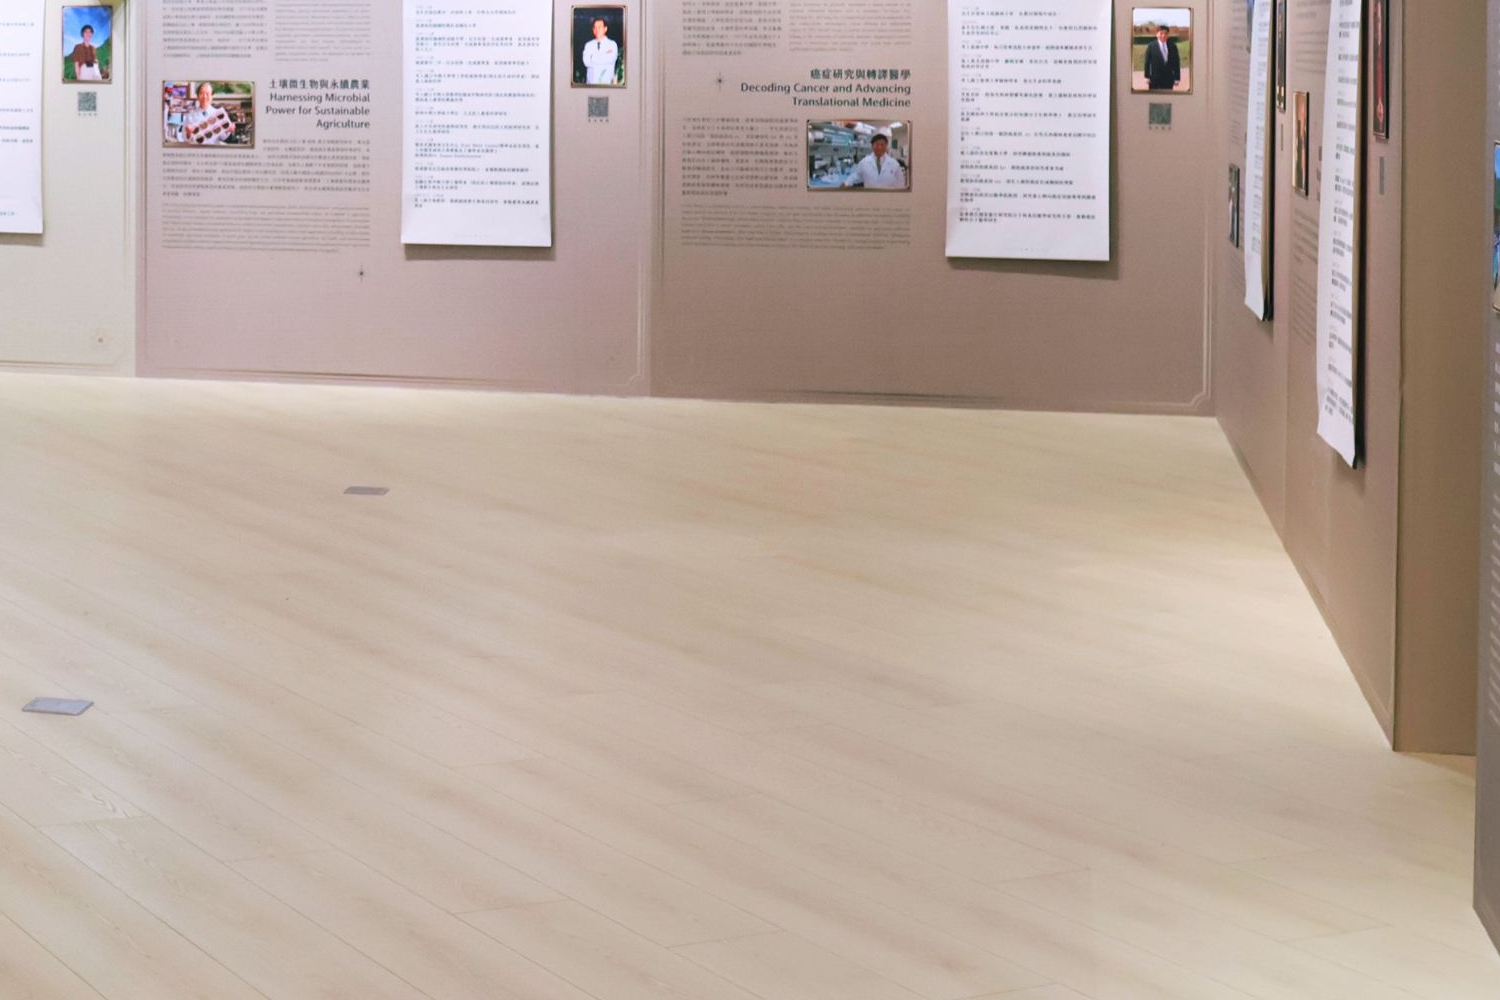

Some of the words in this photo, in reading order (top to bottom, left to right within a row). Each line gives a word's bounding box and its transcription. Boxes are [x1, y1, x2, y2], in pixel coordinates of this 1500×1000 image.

[810, 69, 911, 80] 癌症研究與轉譯醫學
[740, 83, 791, 94] Decoding
[794, 83, 829, 93] Cancer
[833, 83, 852, 93] and
[856, 84, 911, 95] Advancing
[270, 93, 322, 104] Harnessing
[325, 93, 370, 102] Microbial
[792, 97, 859, 107] Translational
[862, 98, 911, 108] Medicine
[266, 106, 295, 115] Power
[299, 105, 312, 115] for
[314, 106, 370, 116] Sustainable
[316, 119, 370, 130] Agriculture
